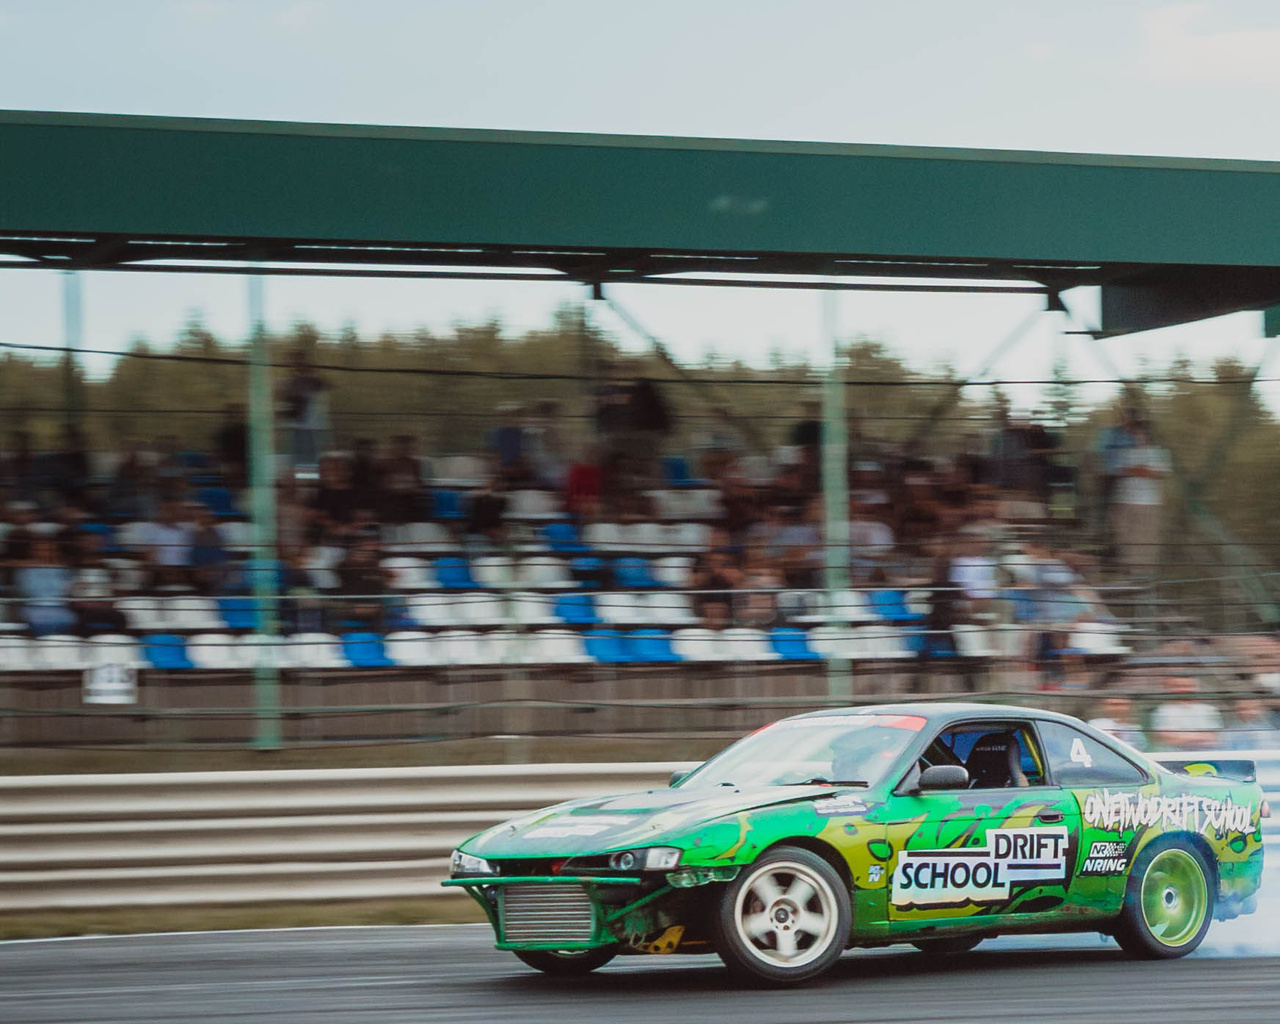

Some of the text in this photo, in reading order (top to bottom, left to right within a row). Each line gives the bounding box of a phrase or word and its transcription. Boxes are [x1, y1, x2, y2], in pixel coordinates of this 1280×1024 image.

[1070, 738, 1092, 767] 4
[994, 834, 1064, 859] DRIFT
[900, 862, 1005, 889] SCHOOL
[1083, 858, 1127, 872] NRING
